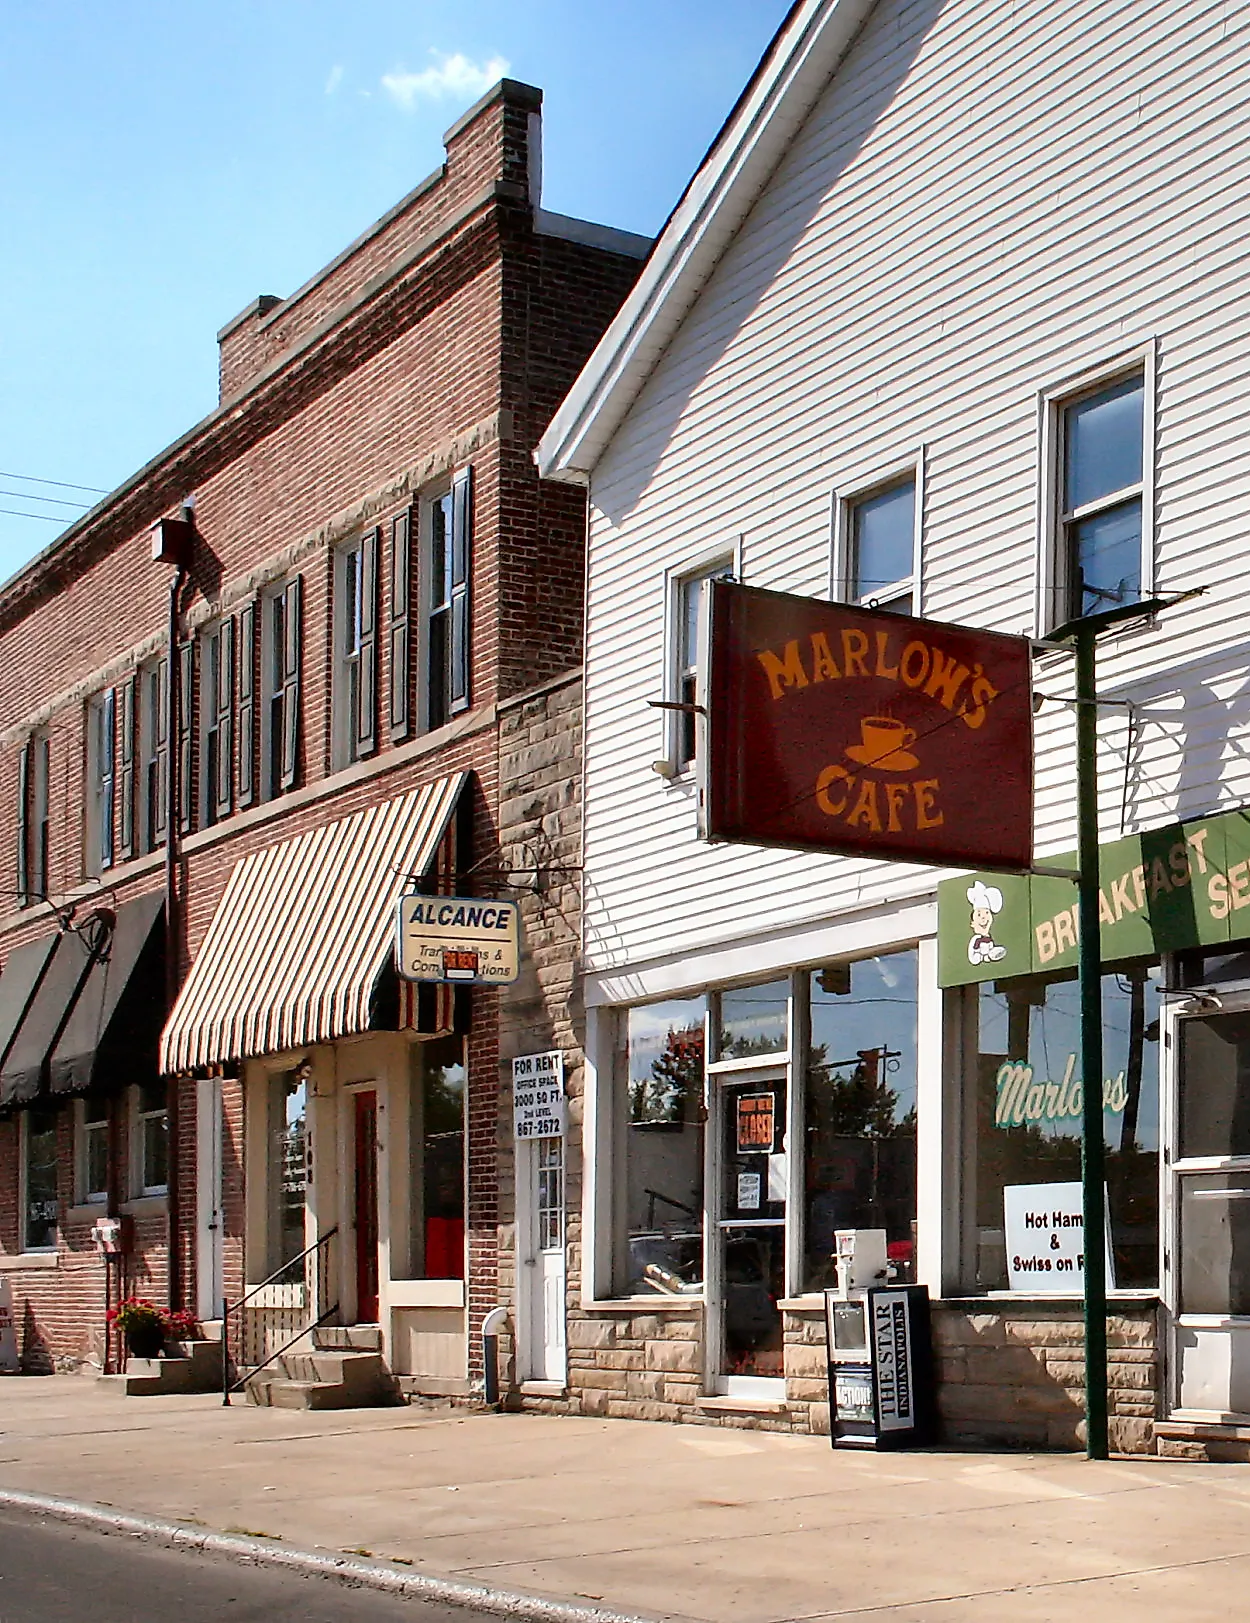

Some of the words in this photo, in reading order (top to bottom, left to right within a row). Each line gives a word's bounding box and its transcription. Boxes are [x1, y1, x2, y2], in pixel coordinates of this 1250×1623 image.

[757, 628, 999, 729] MARLOW'S
[816, 764, 944, 832] CAFE
[1035, 829, 1208, 964] BRAKFAST
[409, 903, 511, 930] ALCANCE
[494, 949, 502, 961] &
[515, 1059, 532, 1075] FOR
[536, 1055, 559, 1072] RENT
[538, 1075, 558, 1087] SPACE
[995, 1053, 1129, 1127] Marlos
[536, 1091, 548, 1104] SQ
[1025, 1212, 1048, 1229] Hot
[1052, 1211, 1083, 1228] Ham
[1050, 1233, 1060, 1250] &
[1013, 1255, 1052, 1272] Swiss
[1056, 1258, 1073, 1271] on
[876, 1303, 894, 1365] STAR
[894, 1308, 908, 1411] INDIANAPOLIS
[879, 1371, 896, 1420] THE
